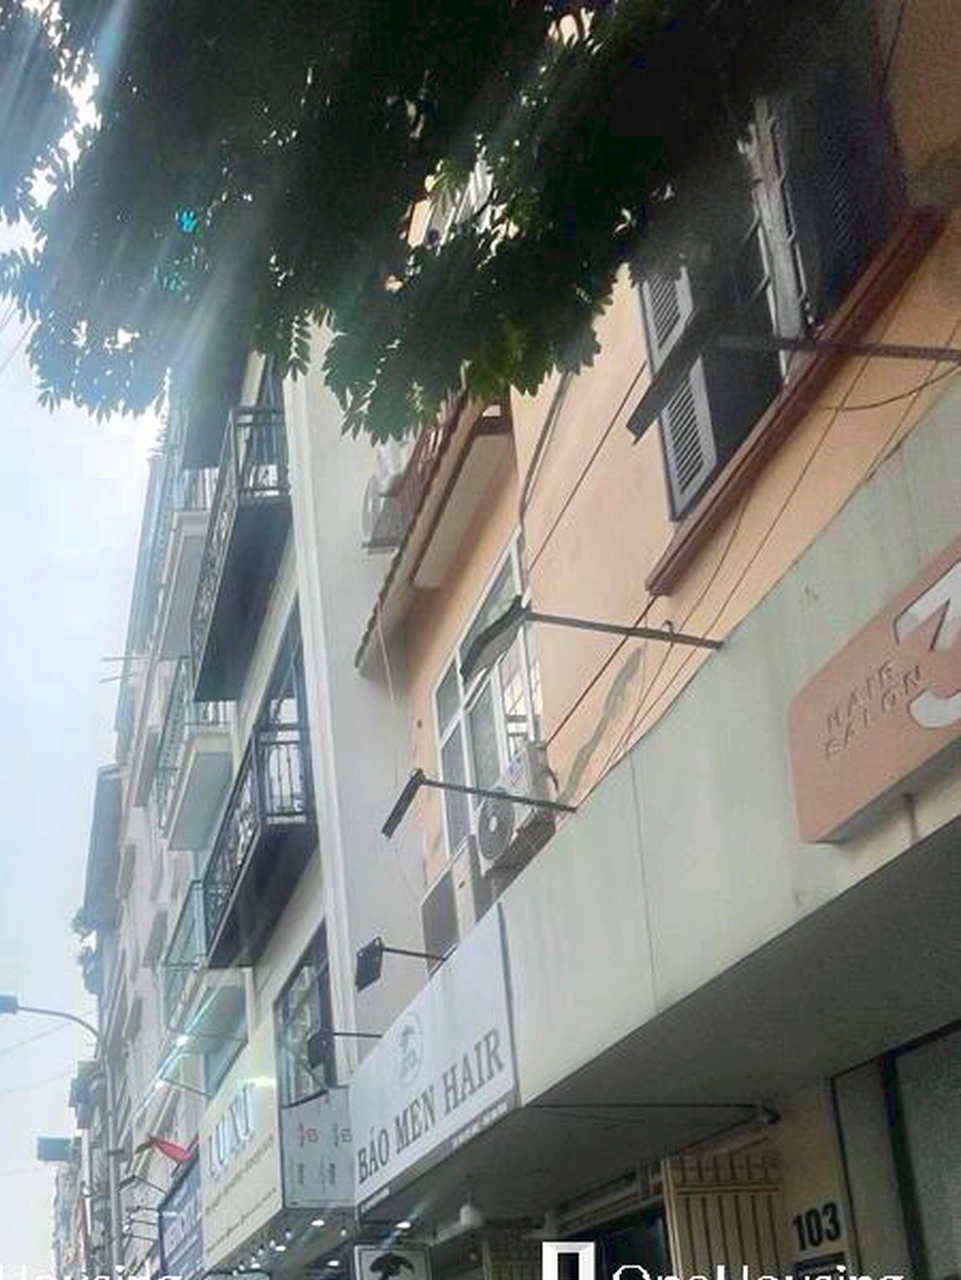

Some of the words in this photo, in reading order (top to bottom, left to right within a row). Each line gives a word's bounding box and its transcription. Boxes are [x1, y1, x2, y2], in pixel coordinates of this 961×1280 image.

[826, 659, 893, 735] HAIR
[394, 1083, 436, 1153] MEN
[442, 1028, 504, 1115] HAIR
[792, 1201, 841, 1251] 103
